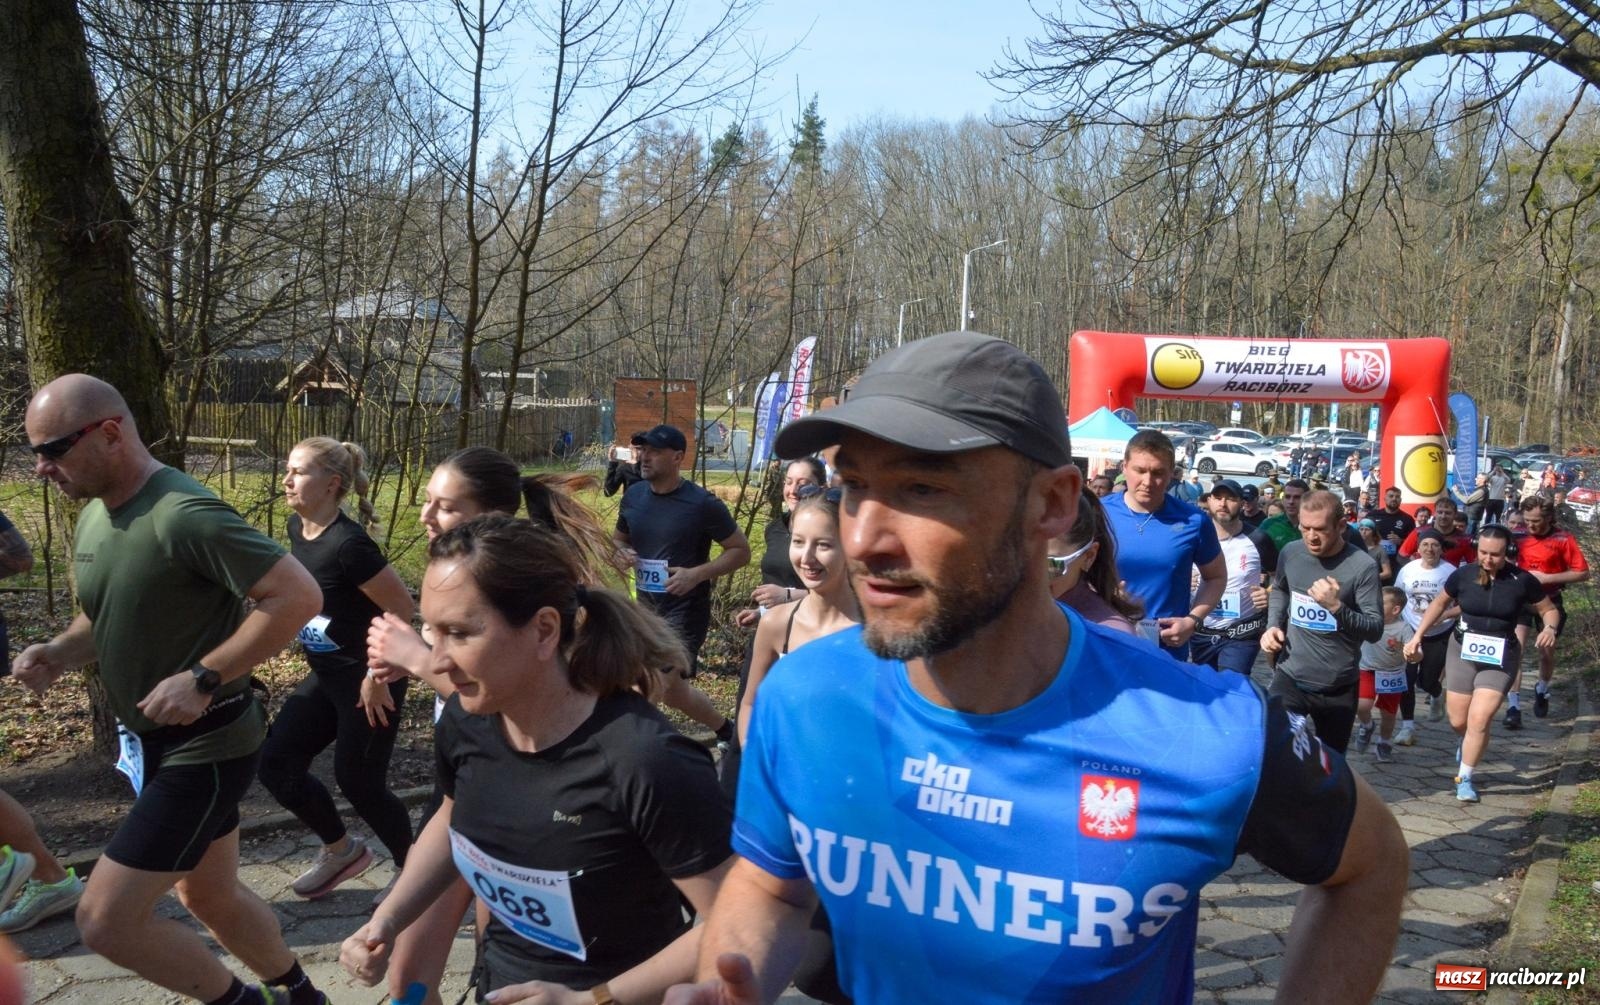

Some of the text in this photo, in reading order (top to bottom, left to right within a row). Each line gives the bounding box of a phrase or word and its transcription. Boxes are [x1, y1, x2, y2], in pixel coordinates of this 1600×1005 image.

[1248, 345, 1290, 356] BIEG
[1214, 361, 1326, 376] TWARDZIELA
[1222, 379, 1313, 393] RACIBÓRZ
[637, 568, 660, 583] 078
[1297, 605, 1328, 621] 009
[1469, 642, 1496, 656] 020
[1081, 759, 1142, 776] POLAND
[786, 811, 1189, 949] RUNNERS
[473, 871, 552, 927] 068
